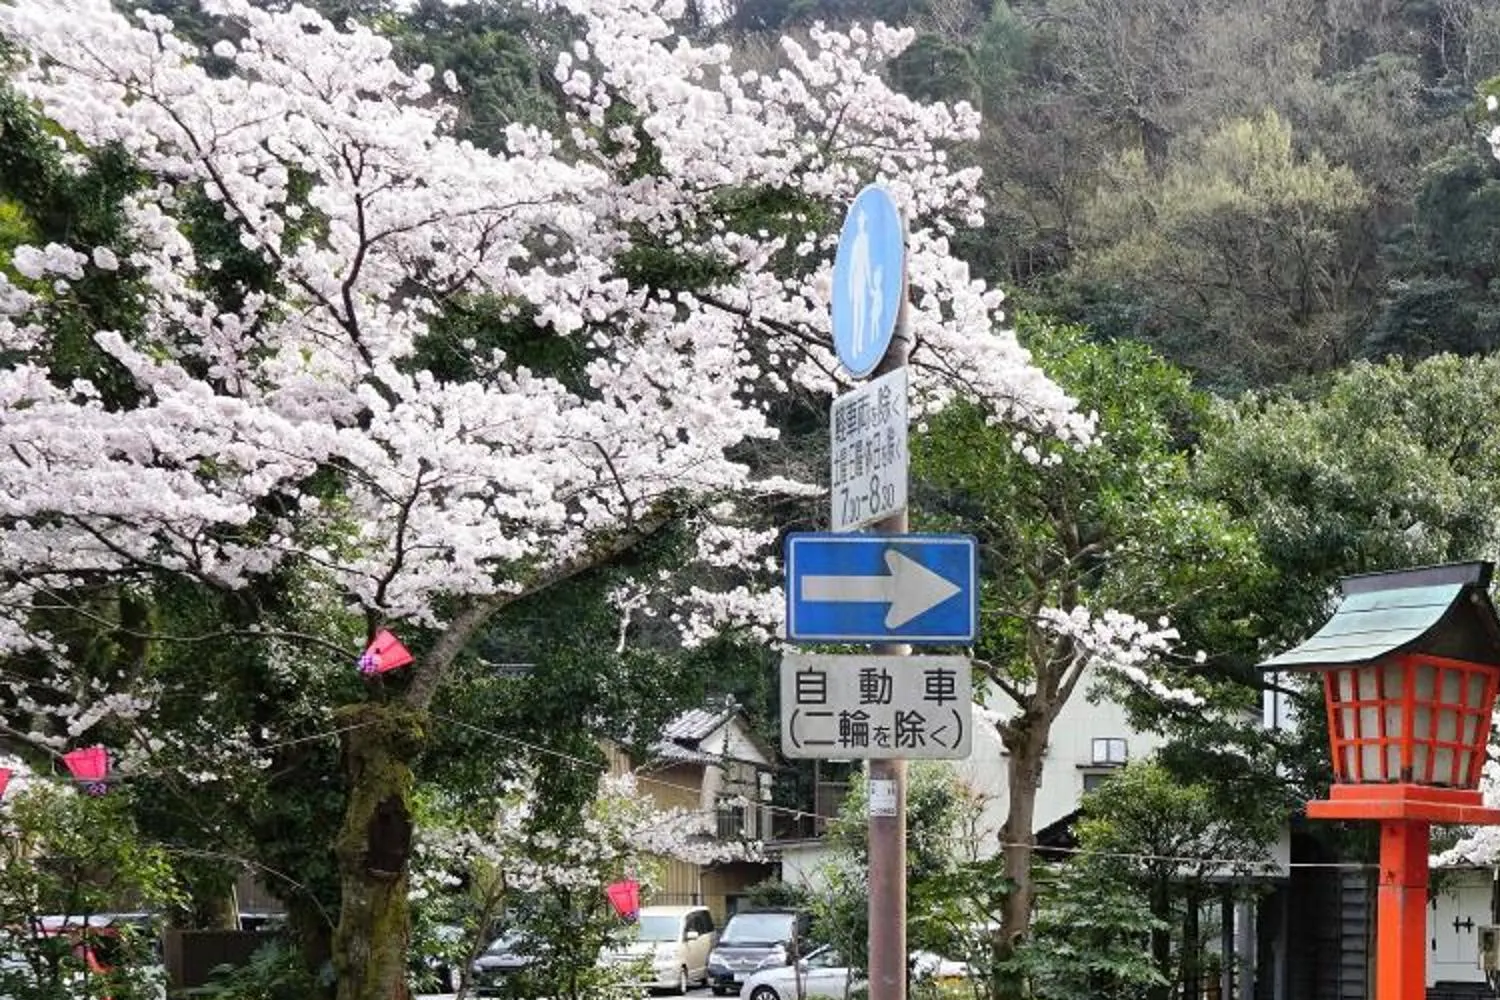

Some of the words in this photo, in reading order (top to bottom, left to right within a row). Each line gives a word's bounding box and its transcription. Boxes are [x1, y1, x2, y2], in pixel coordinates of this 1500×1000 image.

[796, 666, 957, 706] 自動車
[790, 708, 962, 749] (二輪を除く)
